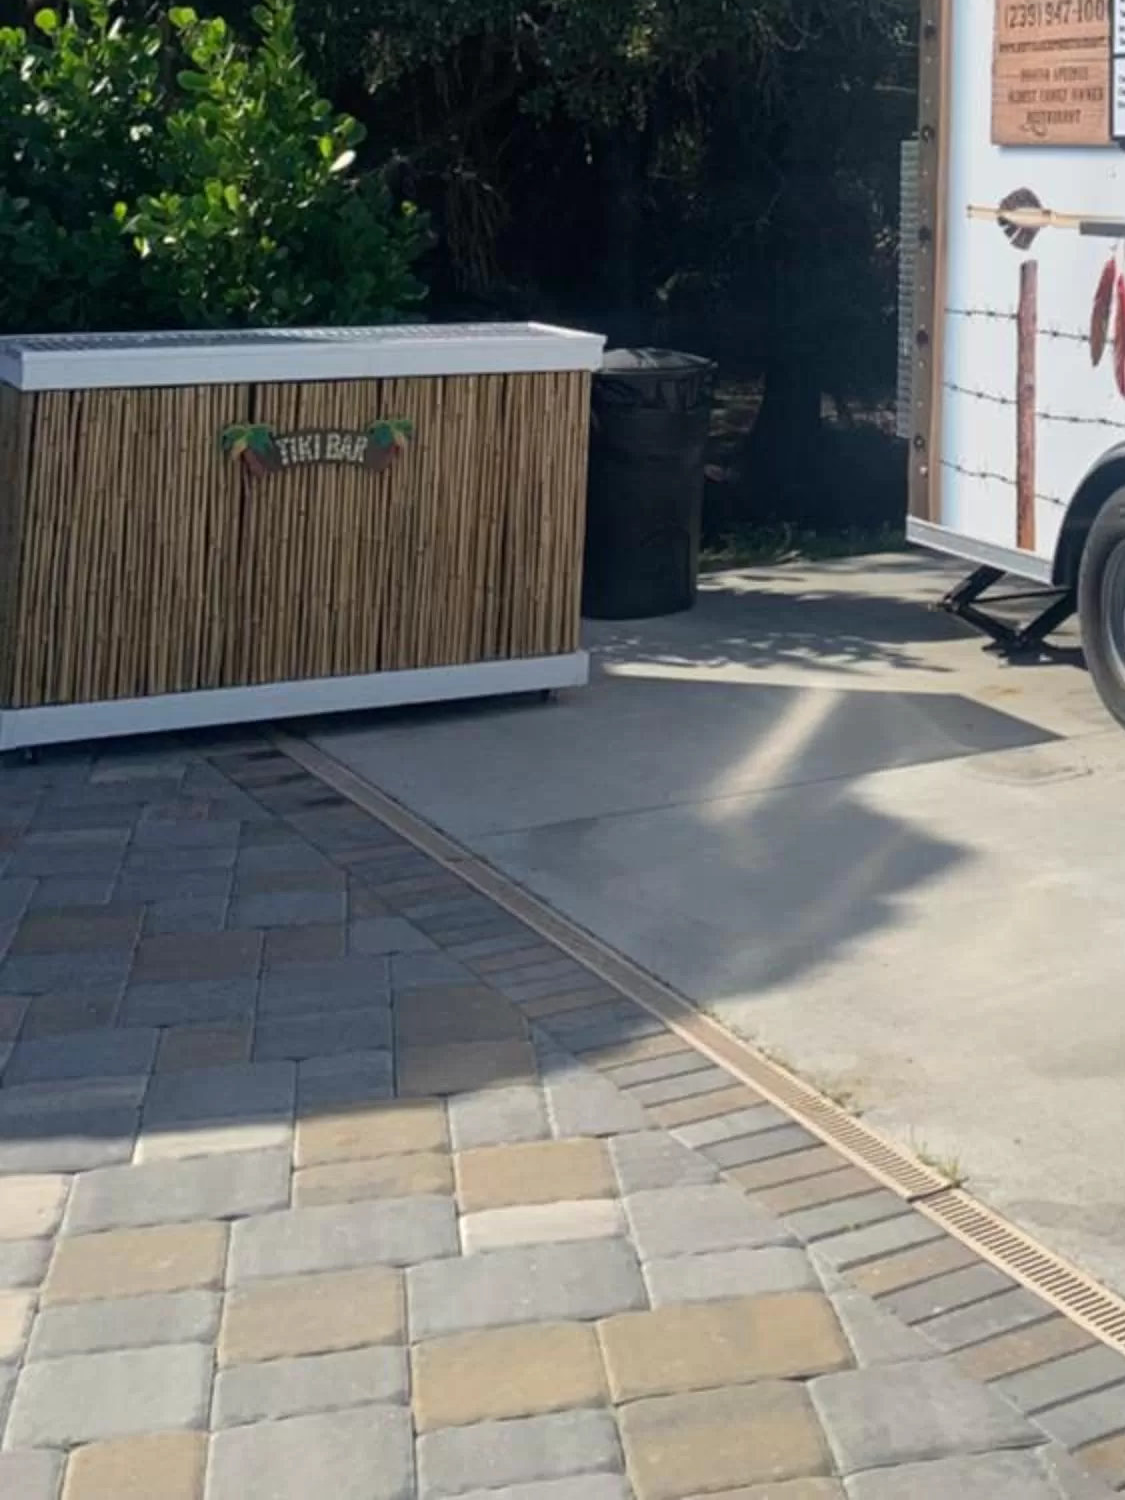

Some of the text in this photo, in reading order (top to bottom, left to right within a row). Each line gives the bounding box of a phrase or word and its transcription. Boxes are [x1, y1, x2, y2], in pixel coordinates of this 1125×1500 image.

[1004, 3, 1043, 29] (239)
[275, 431, 369, 466] TIKI BAR
